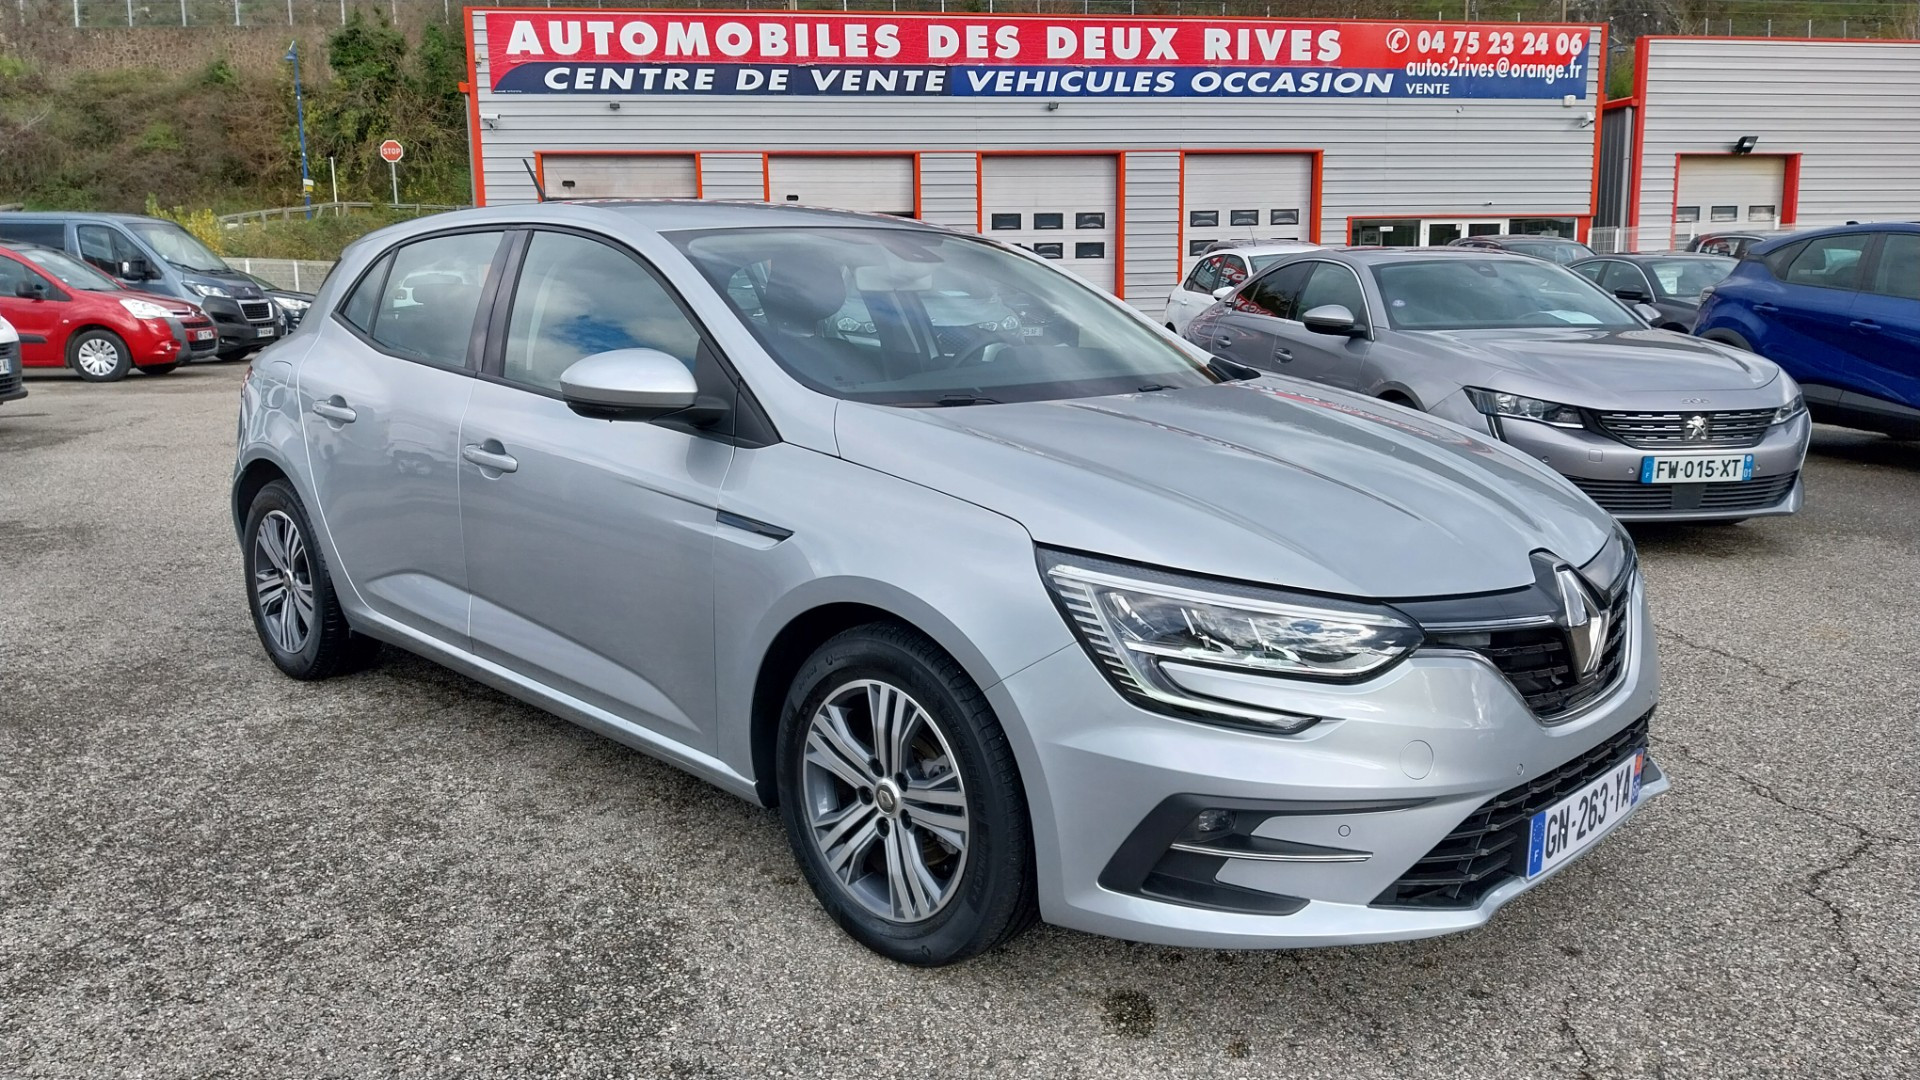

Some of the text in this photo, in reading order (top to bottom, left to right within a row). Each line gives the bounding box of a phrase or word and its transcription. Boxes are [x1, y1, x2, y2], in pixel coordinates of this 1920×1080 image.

[505, 20, 1342, 62] AUTOMOBILES DES DEUX RIVES
[1417, 30, 1583, 56] 04 75 23 24 06
[543, 67, 1395, 94] CENTRE DE VENTE VEHICULES OCCASION
[1406, 55, 1582, 85] autos2rives@orange.fr
[1405, 83, 1450, 95] VENTE
[383, 147, 401, 155] STOP
[1656, 458, 1742, 479] FW-015-XT
[1545, 765, 1632, 859] GN-263-YA
